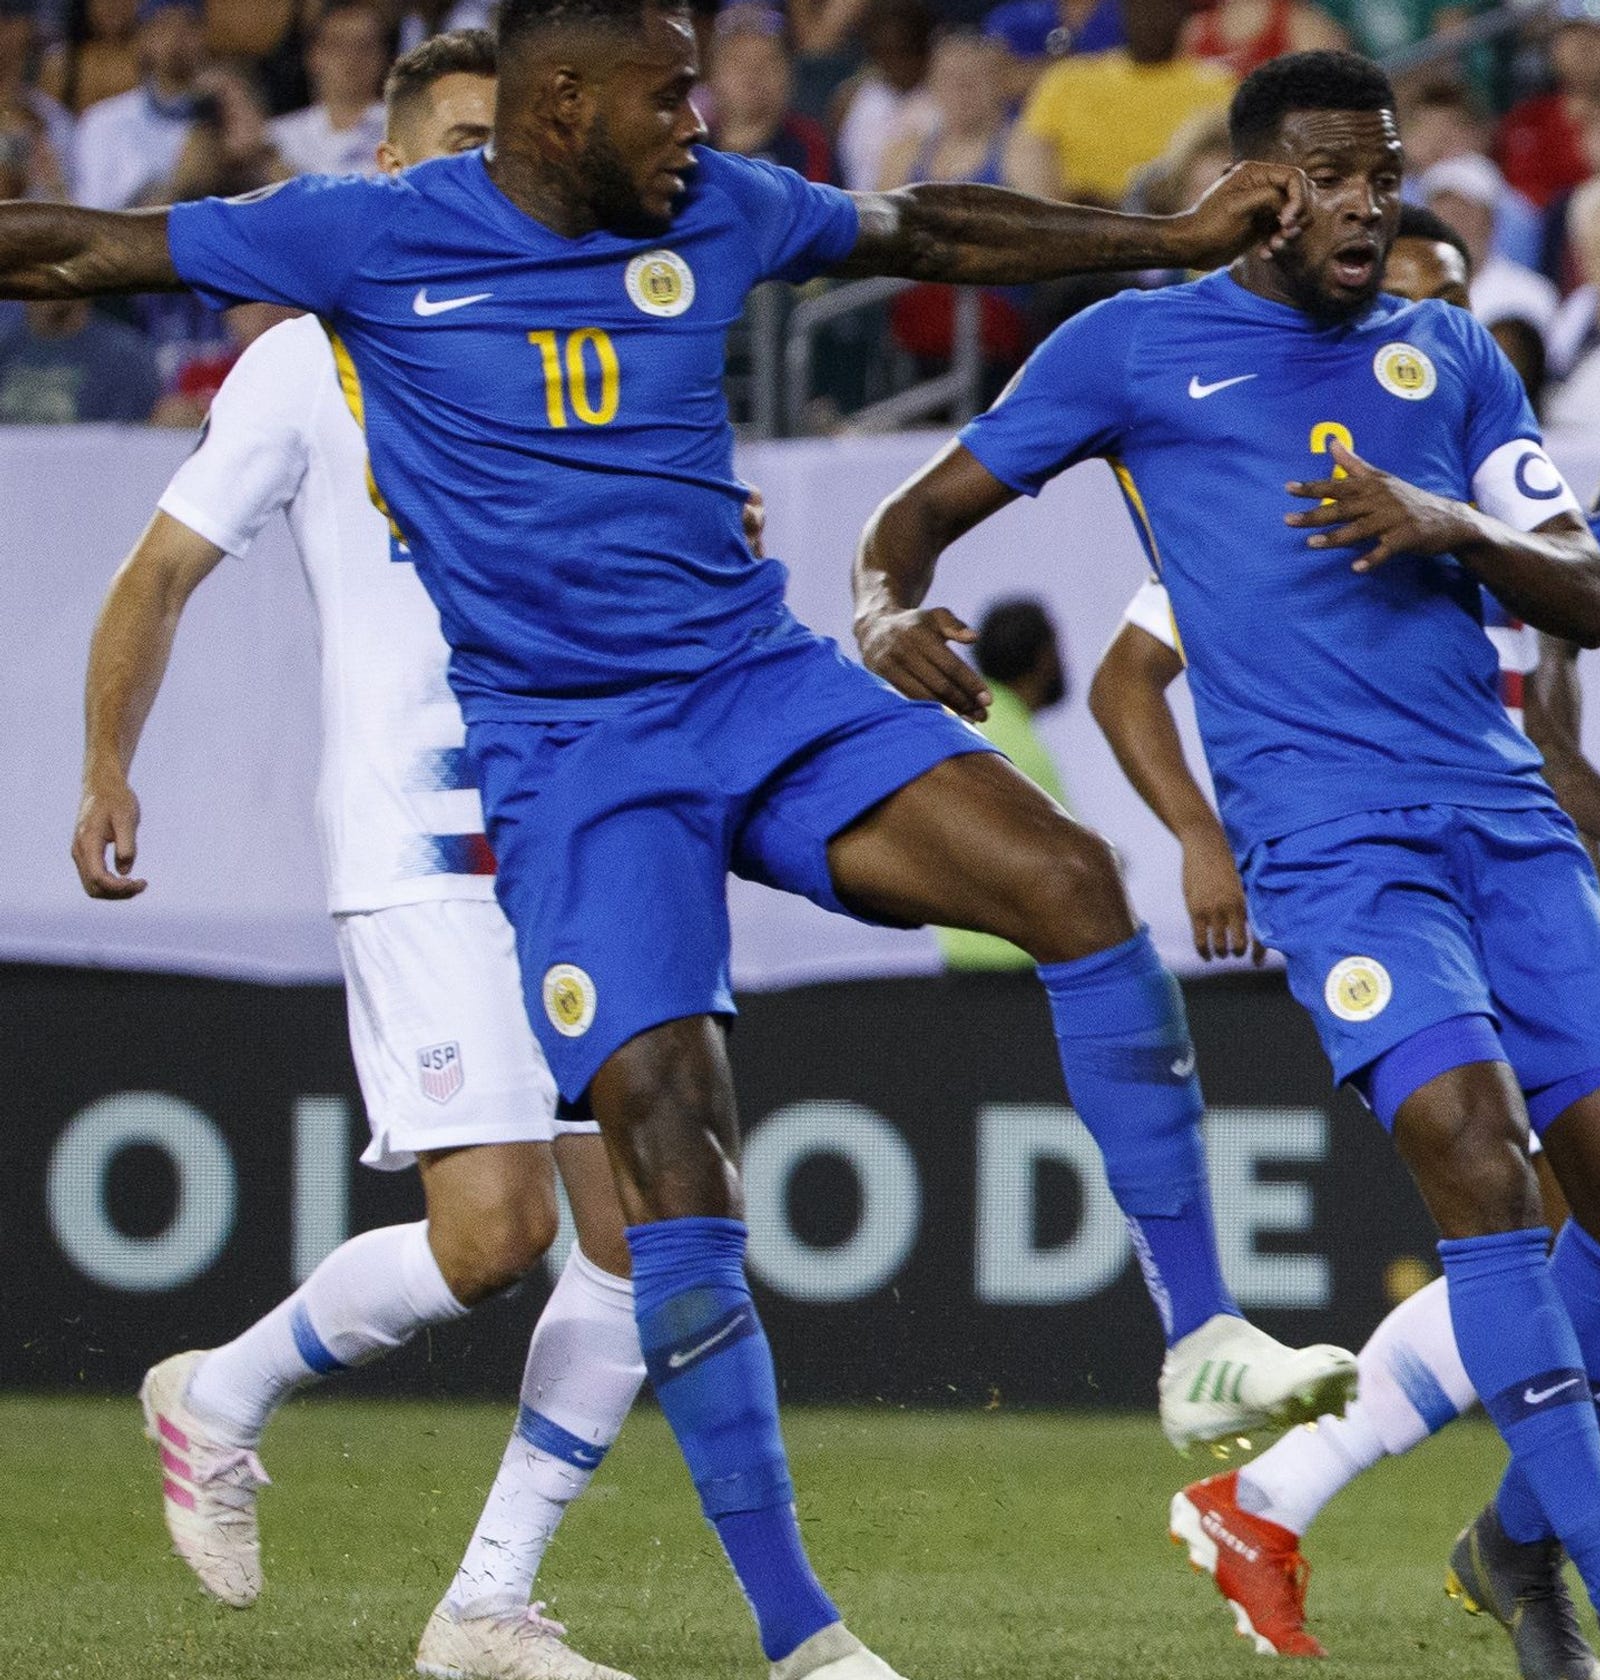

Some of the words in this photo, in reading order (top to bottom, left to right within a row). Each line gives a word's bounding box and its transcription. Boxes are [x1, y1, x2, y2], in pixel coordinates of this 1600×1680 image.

[527, 326, 620, 429] 10
[1514, 451, 1563, 500] C
[421, 1046, 455, 1070] USA
